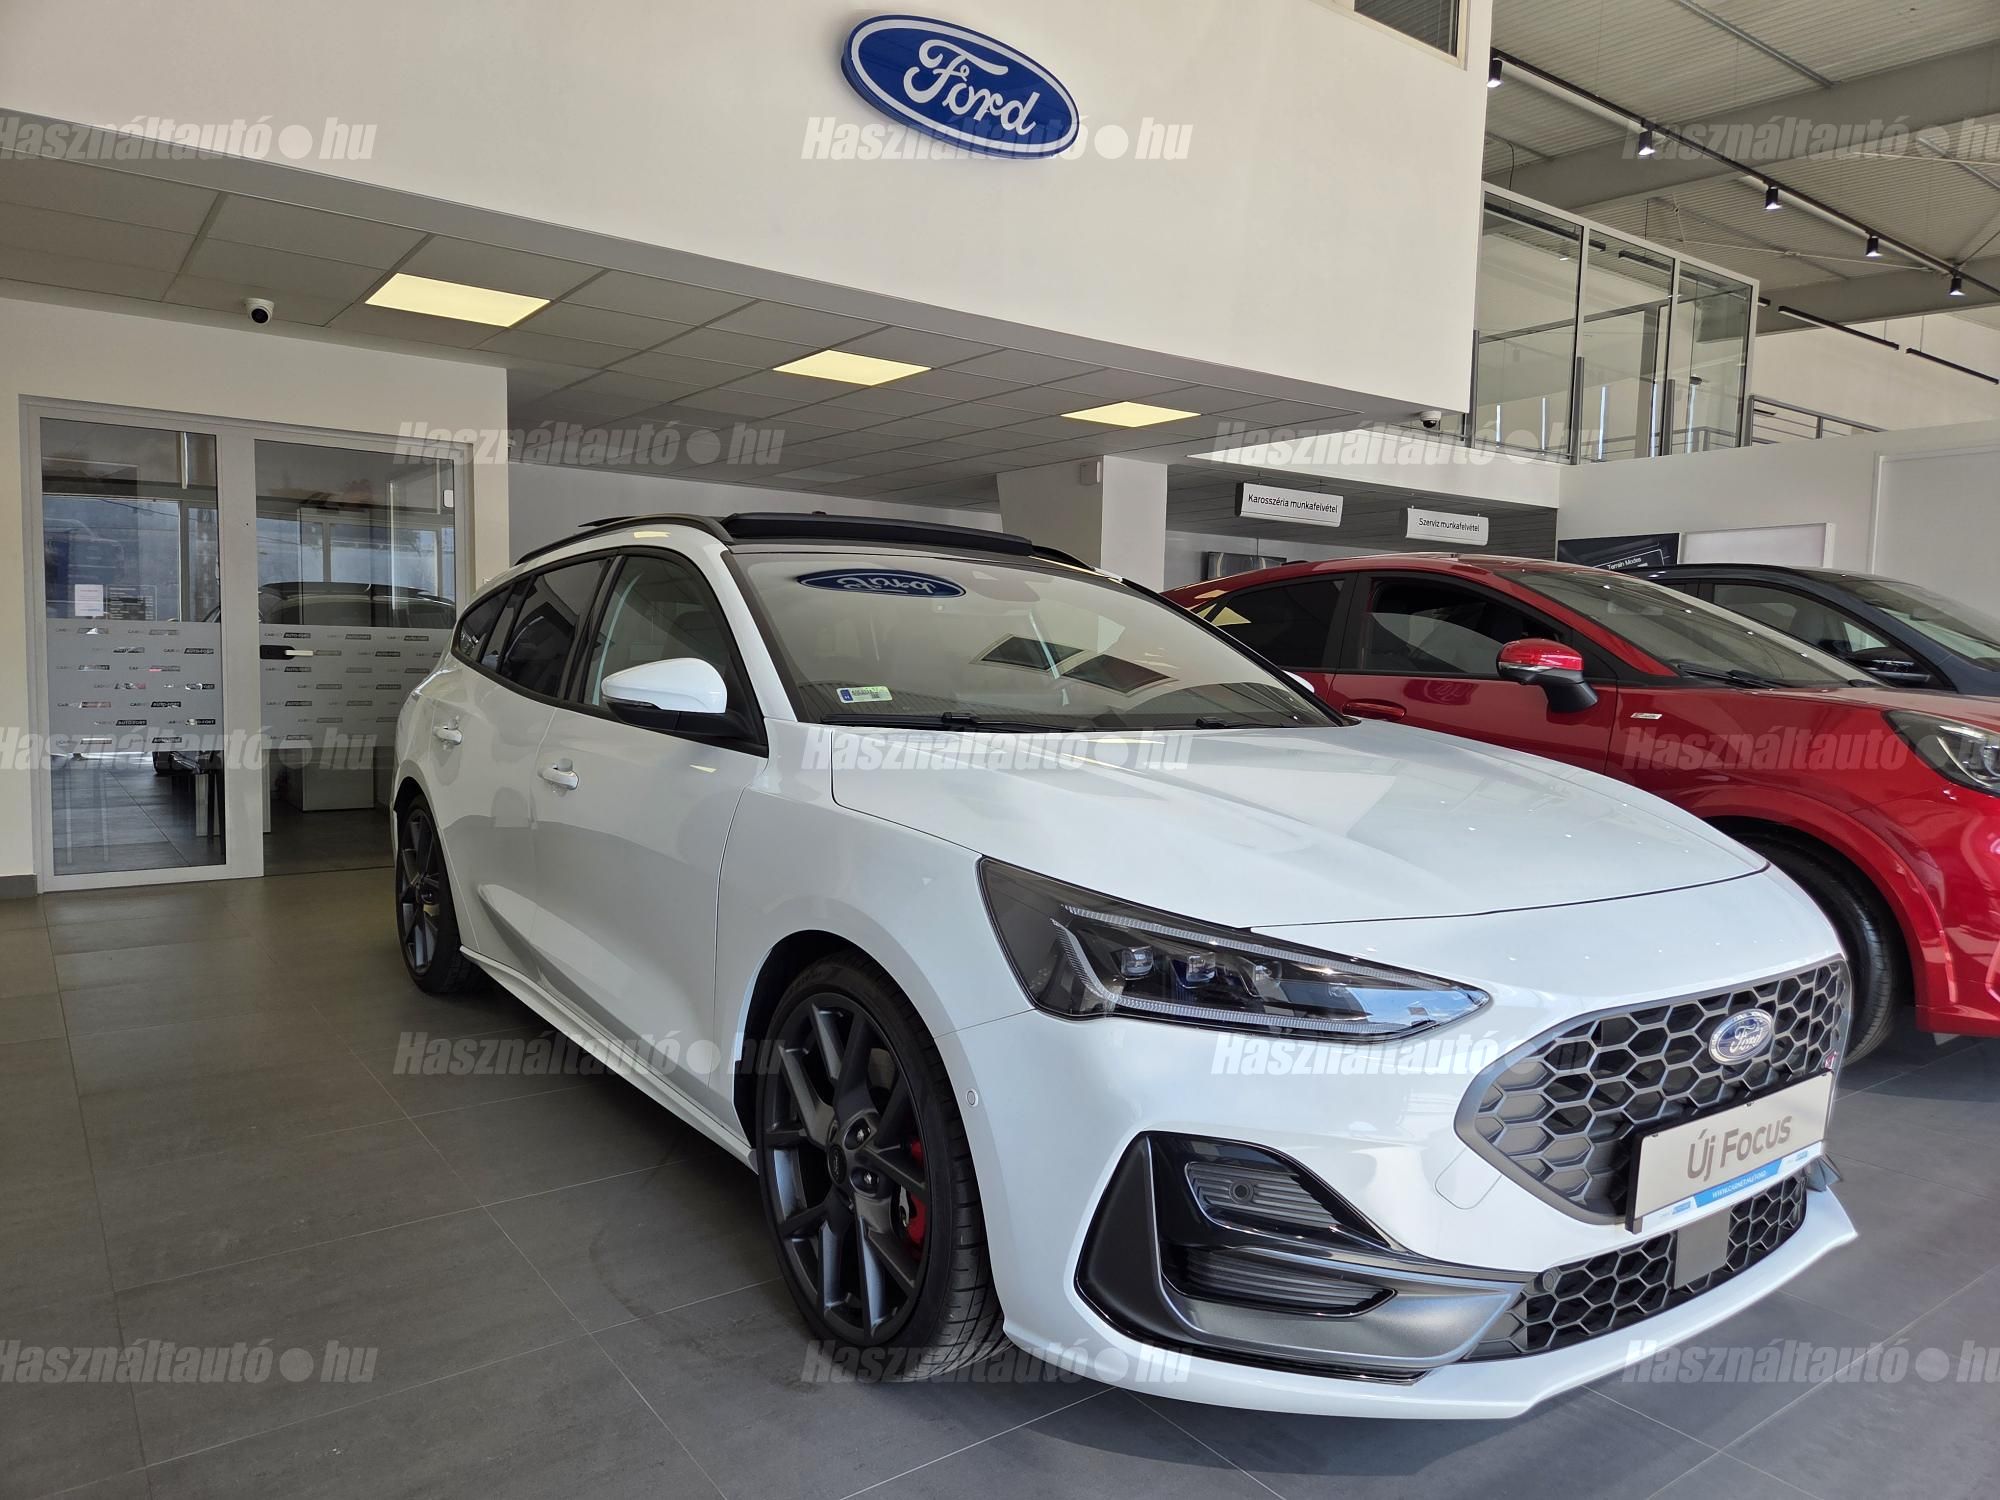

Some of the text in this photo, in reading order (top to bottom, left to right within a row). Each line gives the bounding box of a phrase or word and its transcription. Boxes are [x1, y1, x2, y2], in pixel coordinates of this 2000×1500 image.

[903, 39, 1040, 135] Ford
[1248, 493, 1338, 513] Karosszéria munkafelvétel
[1440, 520, 1480, 532] munkafelvétel
[1730, 1023, 1764, 1053] Ford
[1687, 1115, 1792, 1182] Új Focus
